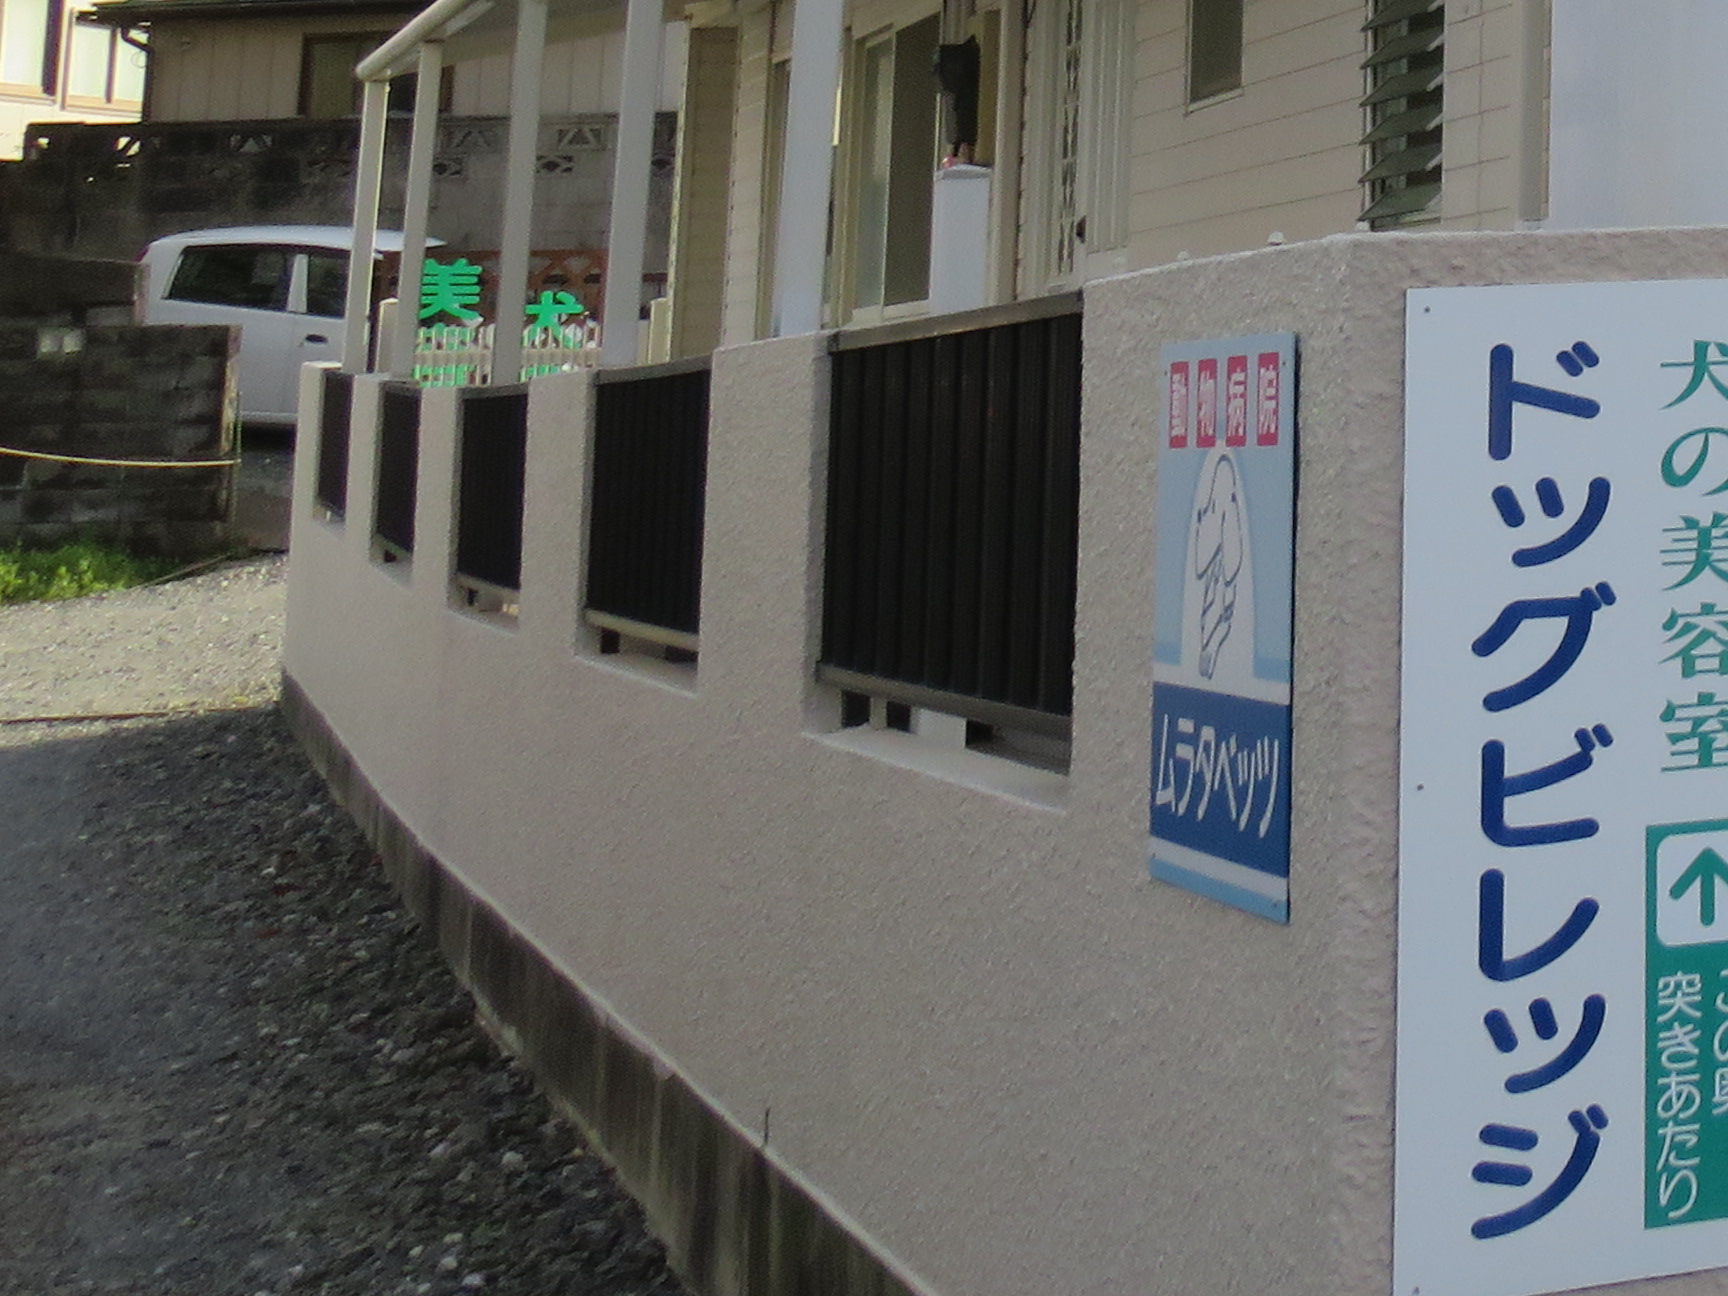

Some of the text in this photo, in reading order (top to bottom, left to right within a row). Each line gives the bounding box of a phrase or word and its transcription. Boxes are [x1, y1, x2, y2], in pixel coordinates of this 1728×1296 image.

[1156, 714, 1280, 838] ムラタベッツ
[1471, 339, 1617, 1239] ドッグビレッジ
[1656, 970, 1703, 1220] 突きあたり
